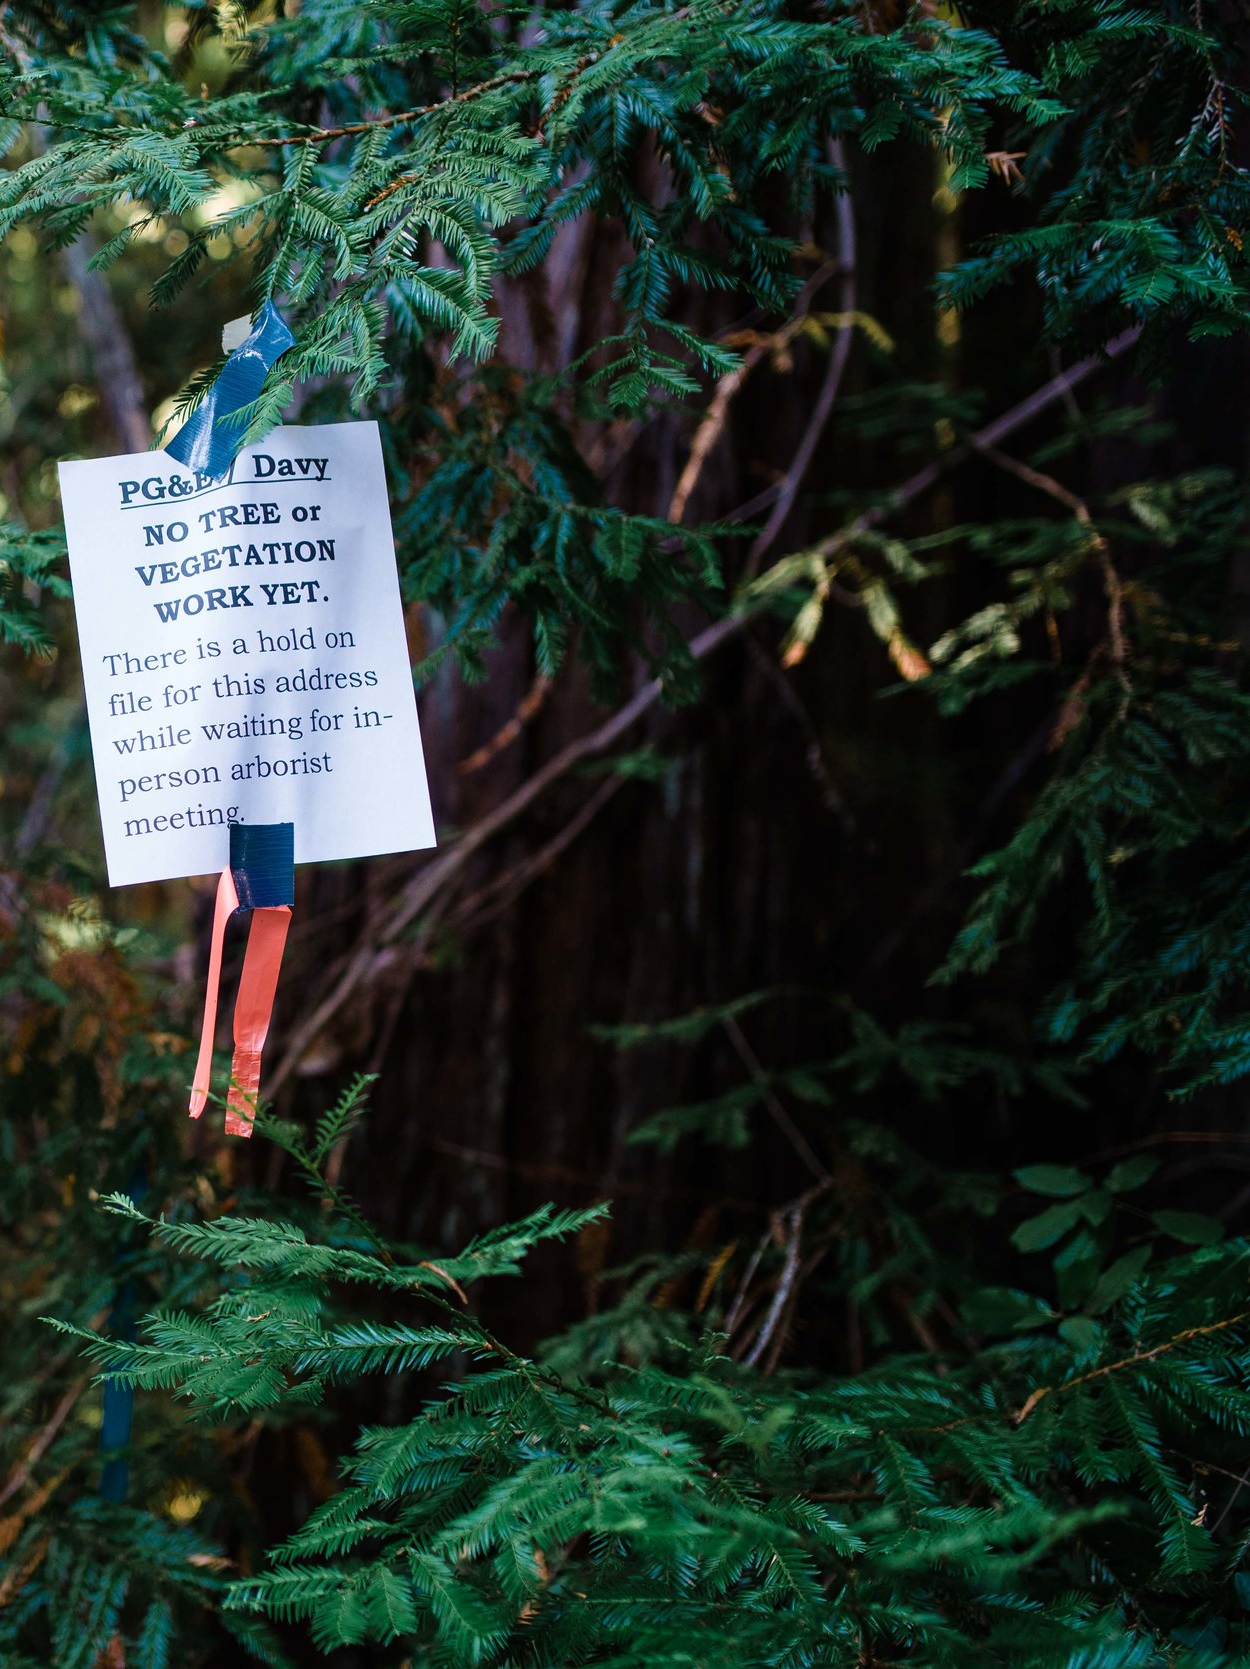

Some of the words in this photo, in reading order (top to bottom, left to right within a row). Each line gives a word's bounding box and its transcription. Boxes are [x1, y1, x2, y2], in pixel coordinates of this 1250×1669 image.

[118, 471, 214, 504] PG&E
[252, 454, 329, 481] Davy
[143, 521, 189, 547] NO
[198, 502, 281, 533] TREE
[291, 505, 321, 522] or
[135, 539, 335, 586] VEGETATION
[153, 585, 253, 623] WORK
[260, 580, 329, 605] YET.
[102, 648, 187, 677] There
[196, 638, 221, 659] is
[232, 637, 250, 655] a
[256, 627, 317, 653] hold
[325, 630, 356, 648] on
[108, 694, 152, 717] file
[163, 684, 201, 708] for
[212, 673, 266, 698] this
[275, 668, 378, 693] address
[112, 725, 192, 755] while
[201, 713, 303, 740] waiting
[310, 709, 343, 732] for
[353, 706, 394, 729] in-
[118, 765, 221, 802] person
[230, 751, 333, 781] arborist
[123, 803, 245, 837] meeting.
